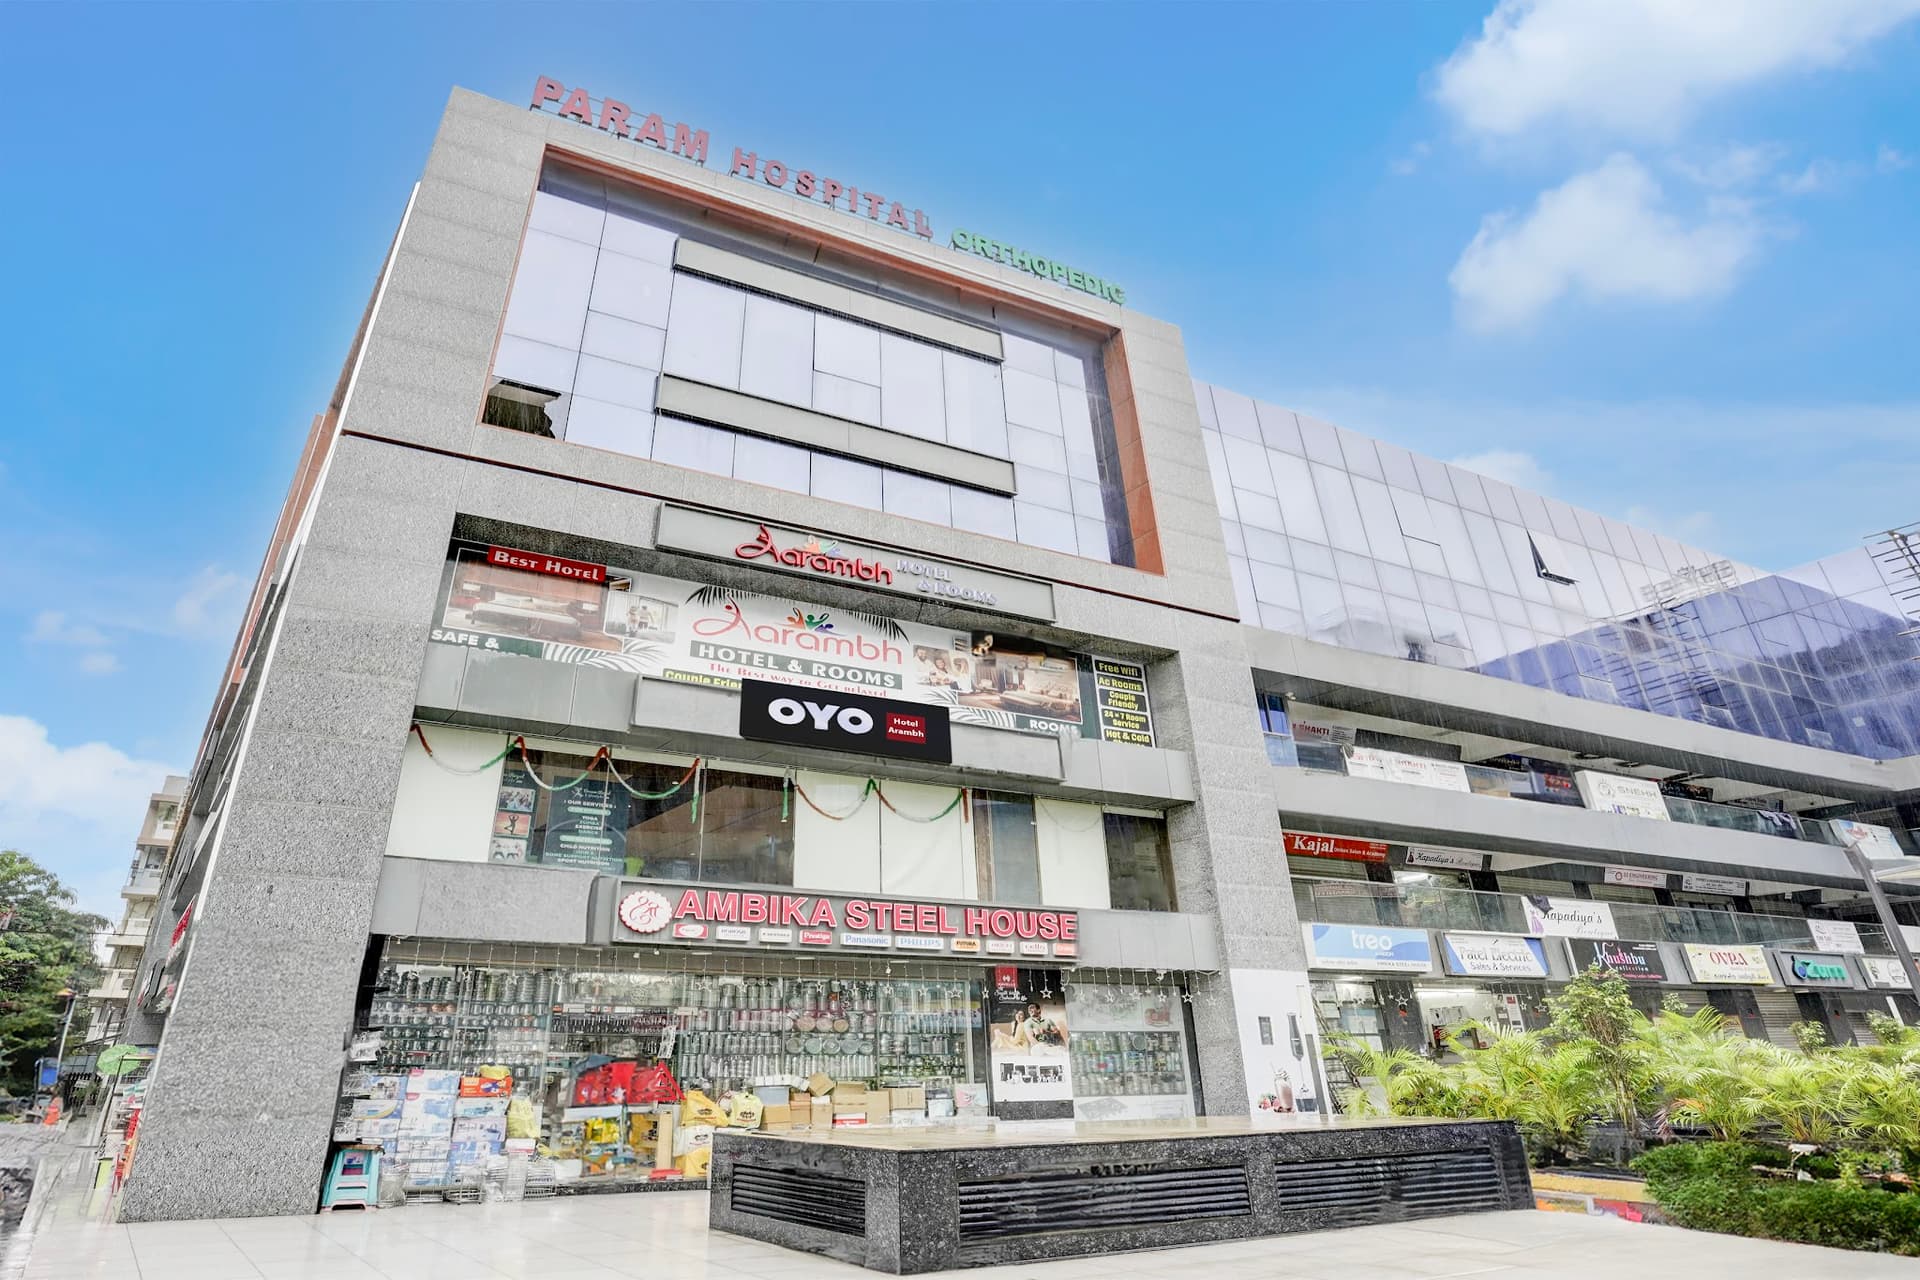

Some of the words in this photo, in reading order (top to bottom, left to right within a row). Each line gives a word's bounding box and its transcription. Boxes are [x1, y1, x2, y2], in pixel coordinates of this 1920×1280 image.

[531, 75, 710, 161] PARAM
[732, 147, 933, 239] HOSPITAL
[952, 228, 1126, 304] ORTHOPEDIC
[735, 524, 893, 585] Aarambh
[896, 560, 952, 582] HOTEL
[934, 582, 998, 606] ROOMS
[431, 629, 479, 647] SAFE
[484, 637, 500, 649] &
[693, 593, 902, 665] Aarambh
[698, 643, 779, 670] HOTEL
[787, 658, 803, 673] &
[812, 662, 896, 688] ROOMS
[1099, 662, 1120, 674] Free
[1109, 690, 1136, 701] Couple
[1112, 680, 1142, 691] Rooms
[1108, 698, 1139, 712] Friendly
[768, 697, 874, 735] OYO
[893, 715, 919, 728] Hotel
[888, 725, 925, 739] Arambh
[1106, 729, 1122, 739] Hot
[1132, 733, 1150, 743] Cold
[1293, 835, 1335, 856] Kajal
[674, 889, 837, 928] AMBIKA
[845, 899, 958, 935] STEEL
[965, 907, 1077, 940] HOUSE
[845, 935, 889, 945] Panasonic
[1352, 929, 1393, 951] treo
